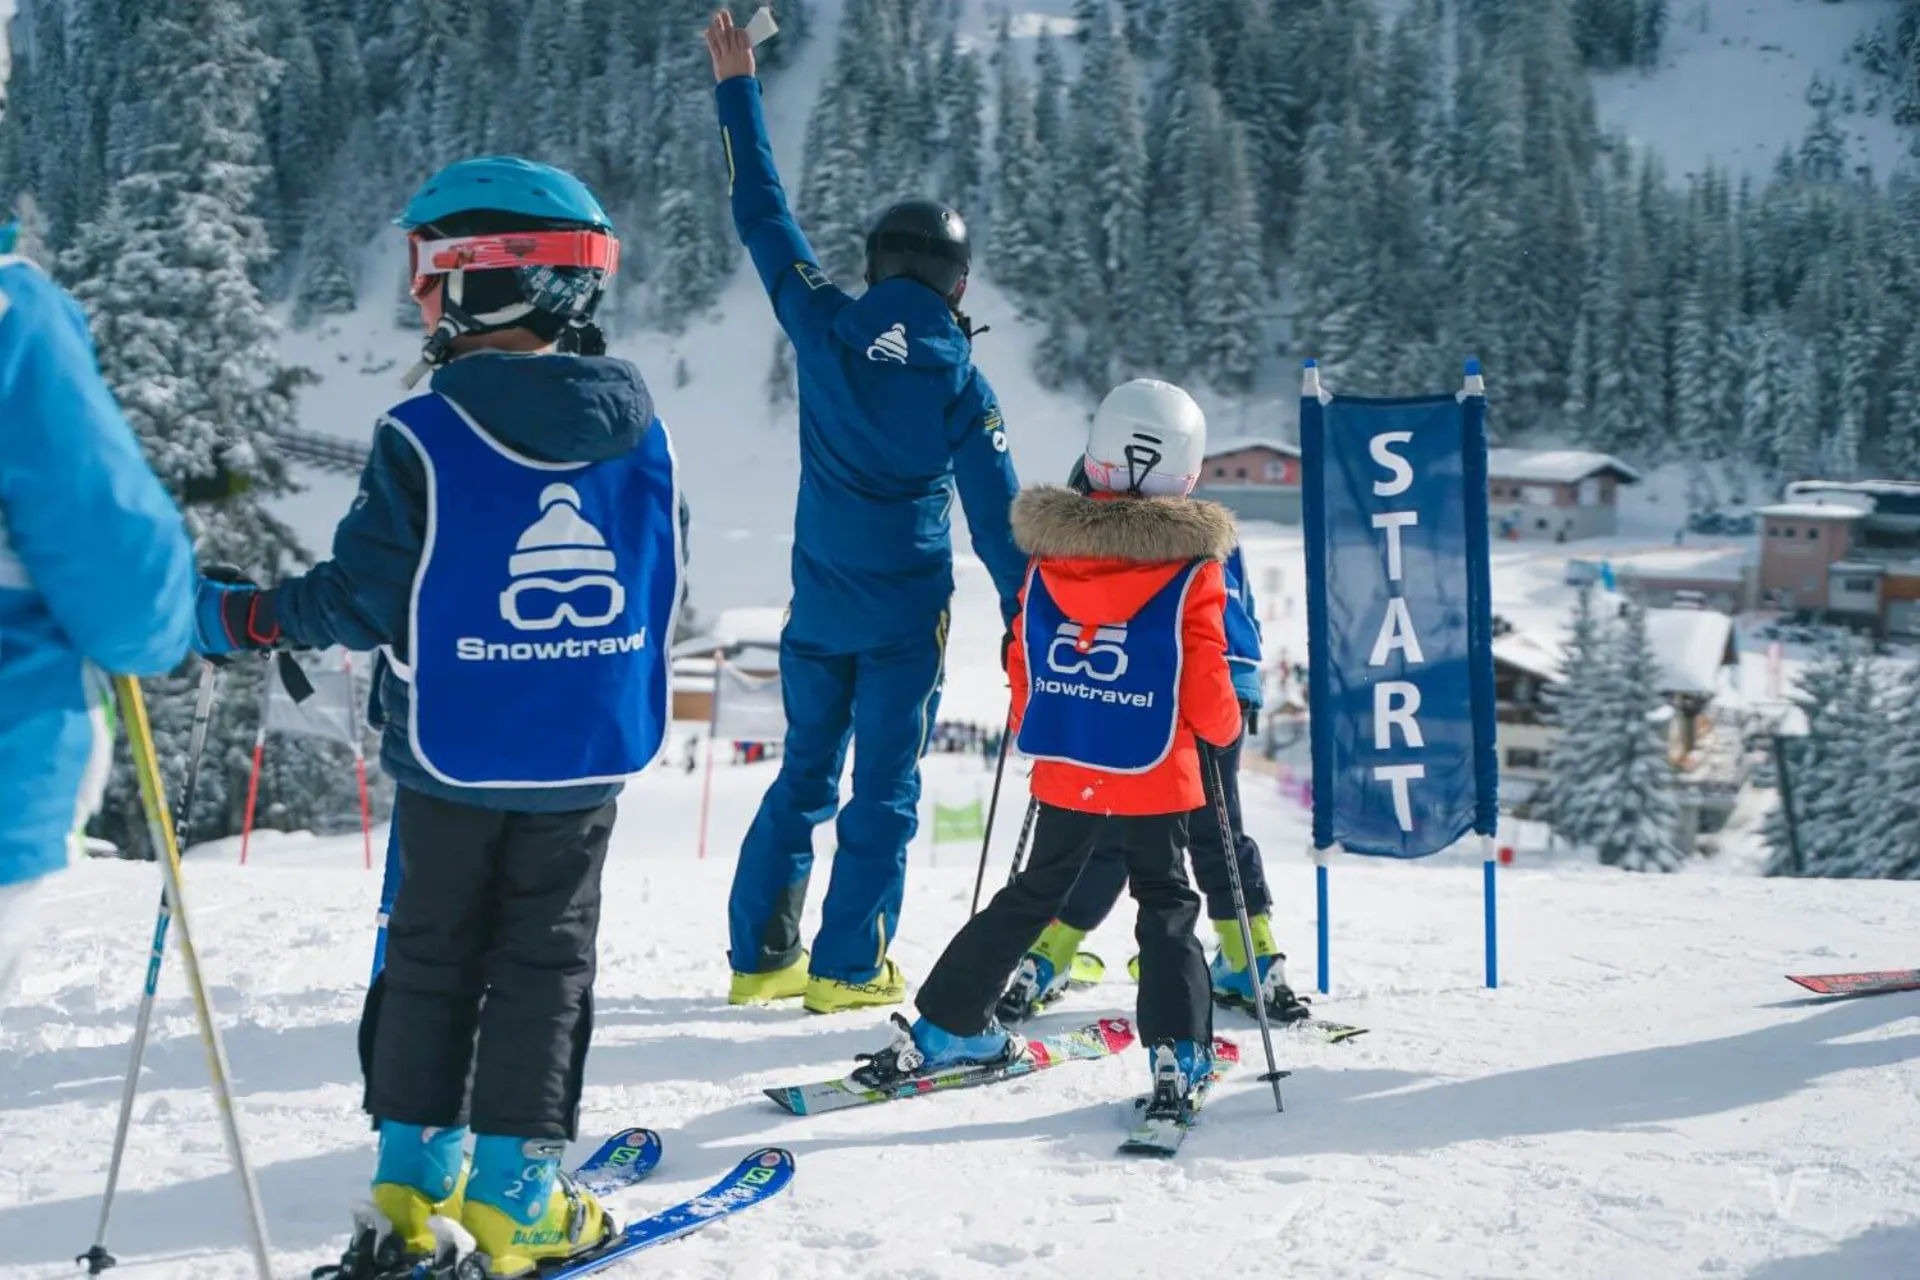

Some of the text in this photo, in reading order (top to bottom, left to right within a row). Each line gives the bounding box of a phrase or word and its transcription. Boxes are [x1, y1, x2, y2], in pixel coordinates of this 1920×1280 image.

[456, 627, 645, 660] Snowtravel
[1368, 430, 1425, 832] START
[1035, 676, 1154, 708] nowtravel
